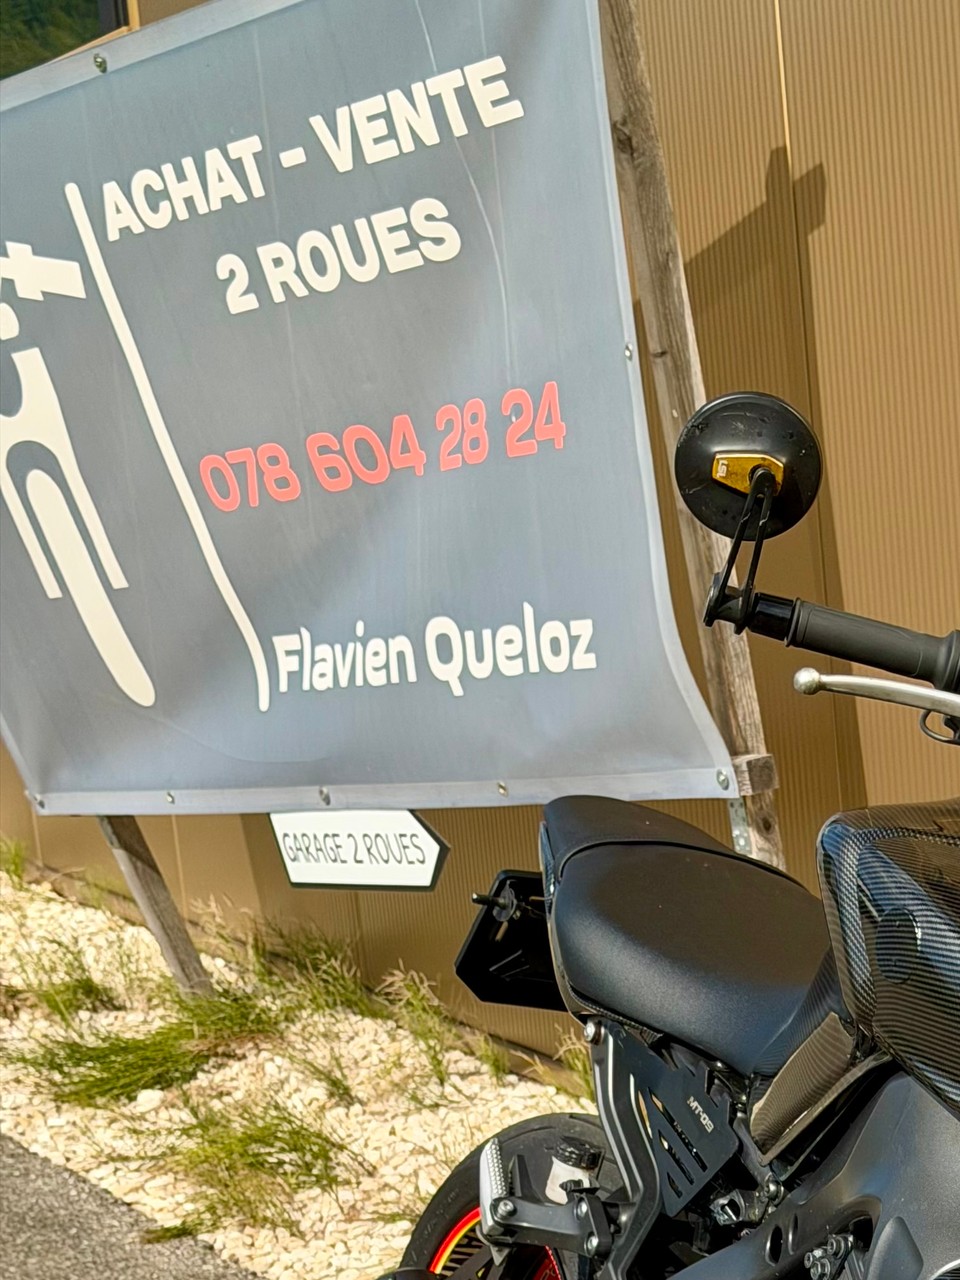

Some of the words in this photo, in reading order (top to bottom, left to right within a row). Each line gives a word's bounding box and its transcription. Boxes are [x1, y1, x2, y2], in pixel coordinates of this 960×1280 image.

[103, 136, 264, 242] ACHAT
[309, 56, 525, 174] VENTE
[216, 254, 260, 315] 2
[256, 198, 462, 303] ROUES
[199, 442, 302, 512] 078
[305, 414, 426, 493] 604
[435, 398, 490, 472] 28
[501, 381, 567, 457] 24
[272, 620, 417, 693] Flavien
[425, 602, 598, 697] Queloz
[281, 832, 348, 865] GARAGE
[346, 832, 365, 865] 2
[362, 832, 427, 866] ROUES
[687, 1096, 715, 1134] MT-09
